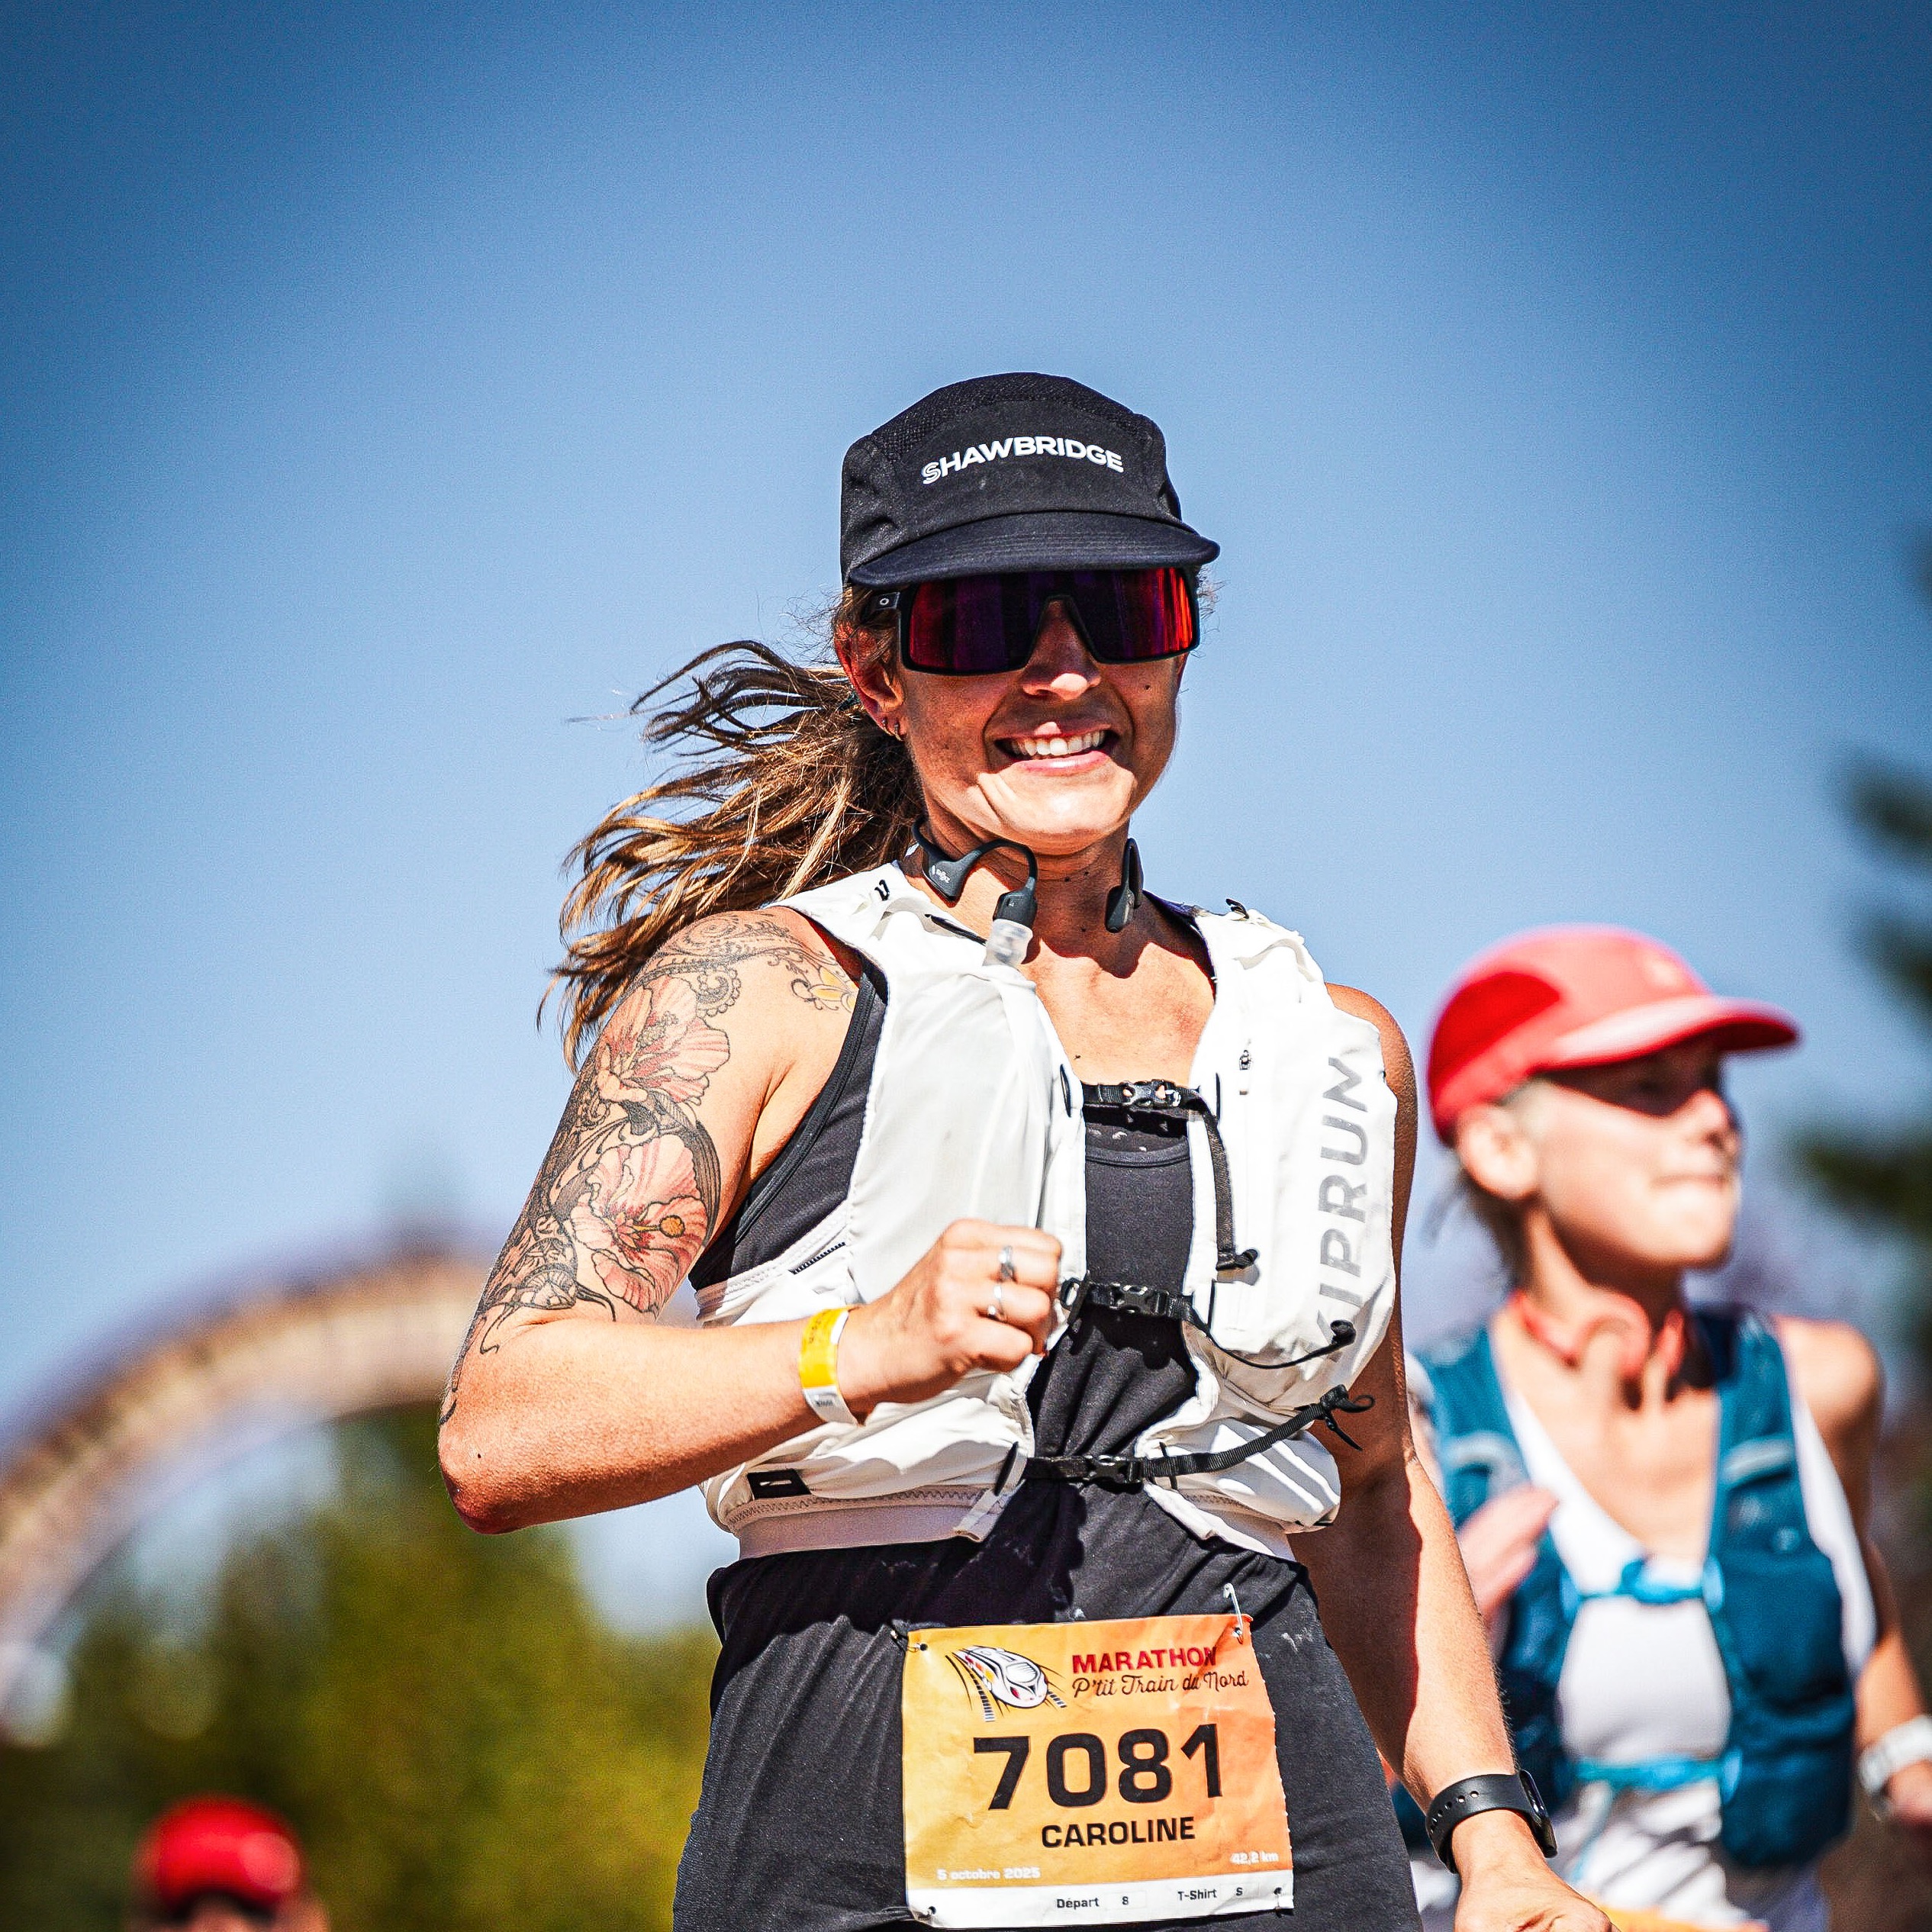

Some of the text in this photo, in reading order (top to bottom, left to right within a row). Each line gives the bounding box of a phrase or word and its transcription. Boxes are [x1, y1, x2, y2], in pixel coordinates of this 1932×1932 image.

[921, 435, 1125, 485] SHAWBRIDGE
[1072, 1646, 1217, 1674] MARATHON
[1072, 1670, 1249, 1699] P'tit Train du Nord
[973, 1723, 1223, 1811] 7081
[1042, 1816, 1196, 1848] CAROLINE
[1261, 1850, 1280, 1862] km
[937, 1867, 1041, 1880] 5 octobre 2025
[1056, 1897, 1100, 1909] Départ
[1178, 1889, 1218, 1901] T-Shirt
